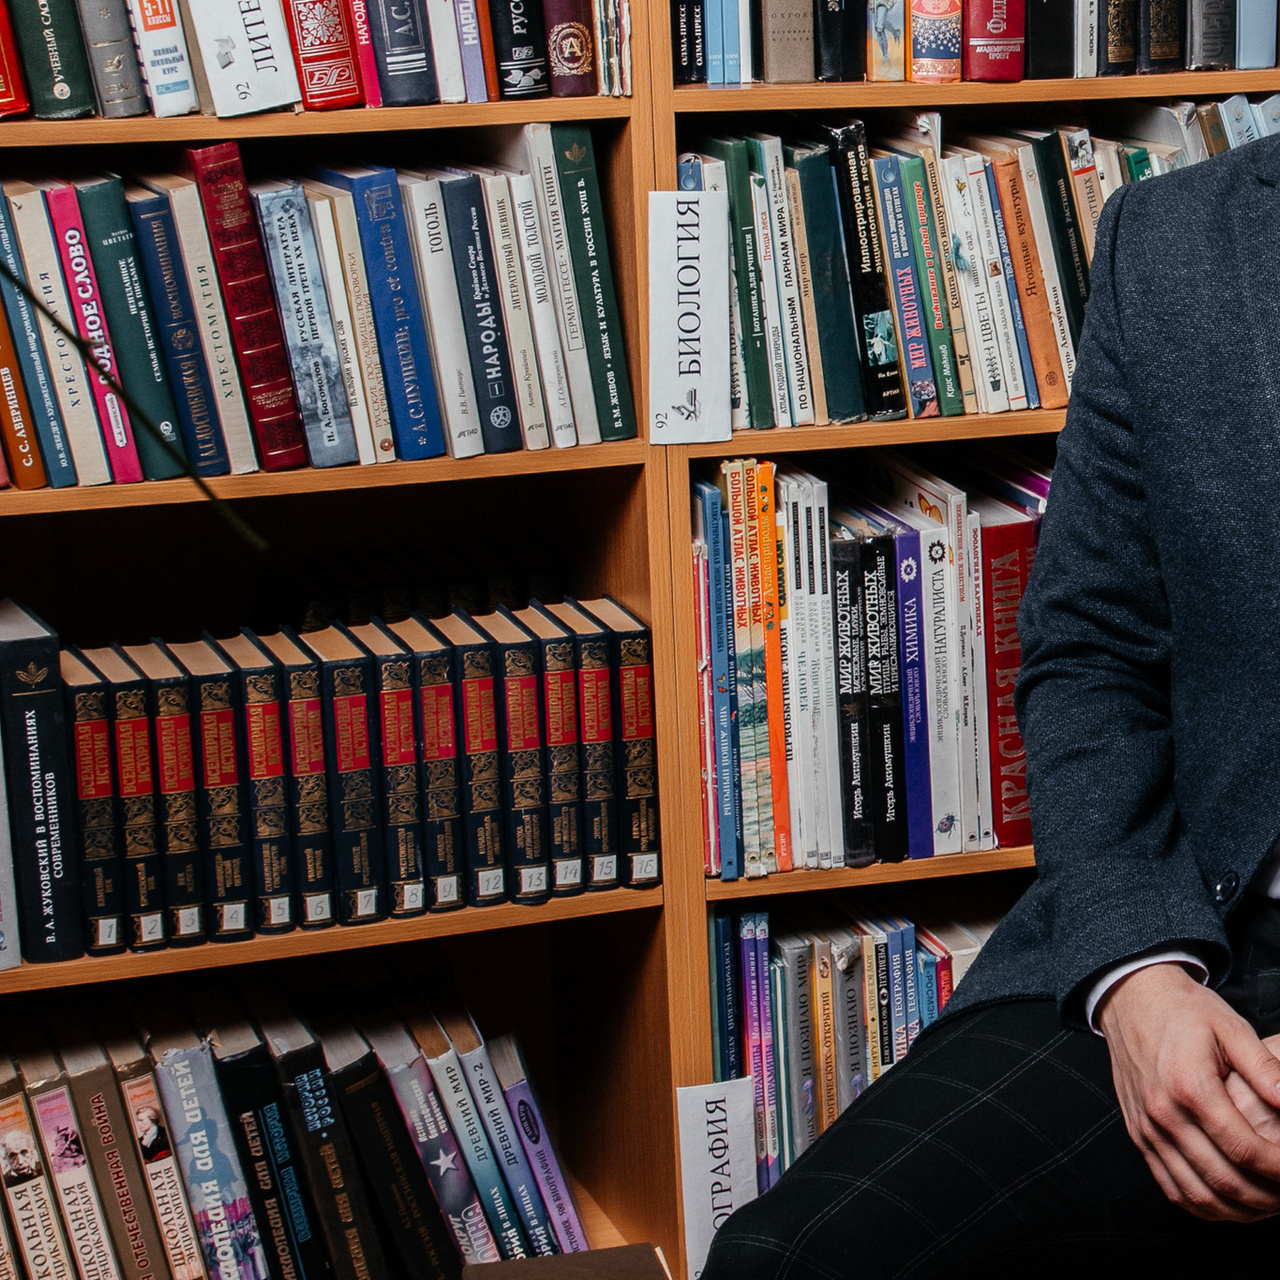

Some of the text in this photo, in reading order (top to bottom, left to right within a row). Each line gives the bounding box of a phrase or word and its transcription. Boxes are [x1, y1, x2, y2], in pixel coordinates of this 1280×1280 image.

[237, 81, 252, 102] 92
[422, 201, 444, 255] ГОГОЛЬ
[521, 199, 550, 305] МОЛОДОЙ ТОЛСТОЙ
[848, 151, 872, 274] Иллюстрированная
[1010, 178, 1038, 297] Ягодные культуры
[196, 264, 235, 399] ХРЕСТОМАТИЯ
[475, 301, 503, 379] НАРОДЫ
[676, 197, 702, 378] БИОЛОГИЯ
[776, 206, 808, 410] ПО НАЦИОНАЛЬНЫМ ПАРКАМ МИРА
[897, 266, 927, 370] МИР ЖИВОТНЫХ
[655, 412, 668, 429] 92
[904, 596, 919, 662] ХИМИКА
[25, 709, 52, 917] ЖУКОВСКИЙ В ВОСПОМИНАНИЯХ
[46, 771, 64, 879] СОВРЕМЕННИКОВ
[89, 1092, 117, 1147] ВОЙНА
[445, 1065, 489, 1163] ДРЕВНИЙ МИР
[705, 1096, 734, 1233] ОГРАФИЯ
[107, 1148, 151, 1271] ОТЕЧЕСТВЕННАЯ
